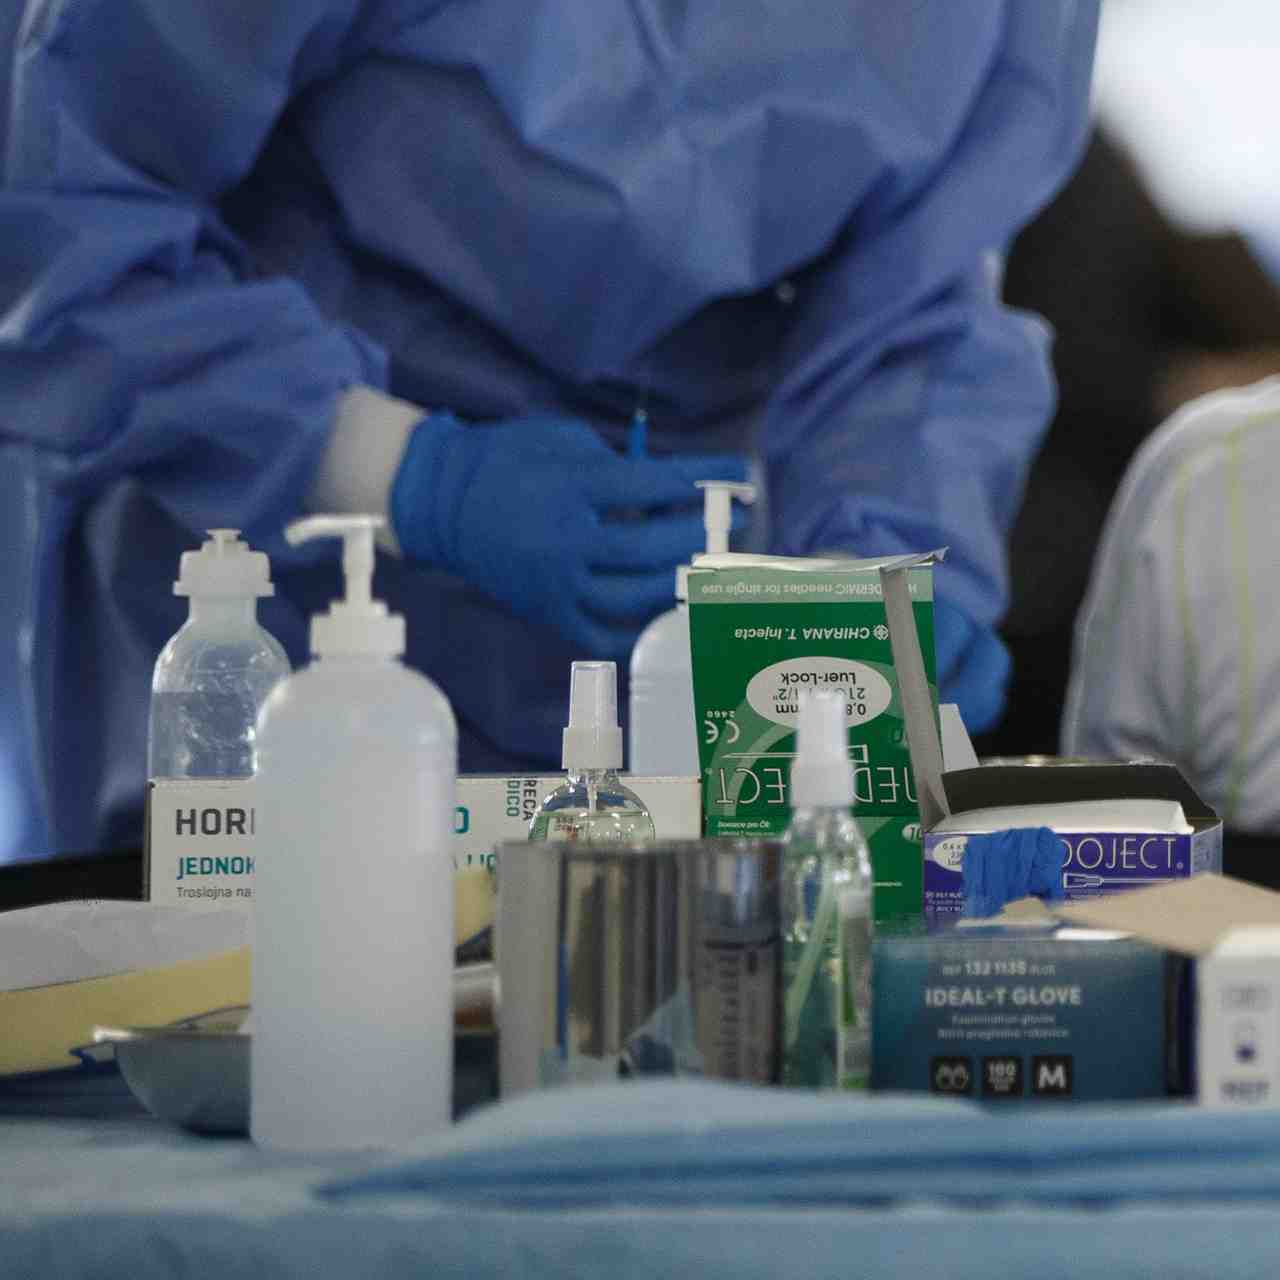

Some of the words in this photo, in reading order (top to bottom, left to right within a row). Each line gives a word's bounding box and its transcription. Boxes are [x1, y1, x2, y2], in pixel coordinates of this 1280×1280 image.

[734, 625, 783, 641] Injecta
[803, 626, 870, 640] CHIRANA
[780, 672, 857, 686] Luer-Lock
[175, 807, 255, 836] HOR
[925, 986, 1006, 1007] IDEAL-T
[1011, 986, 1082, 1006] GLOVE
[1038, 1064, 1066, 1089] M
